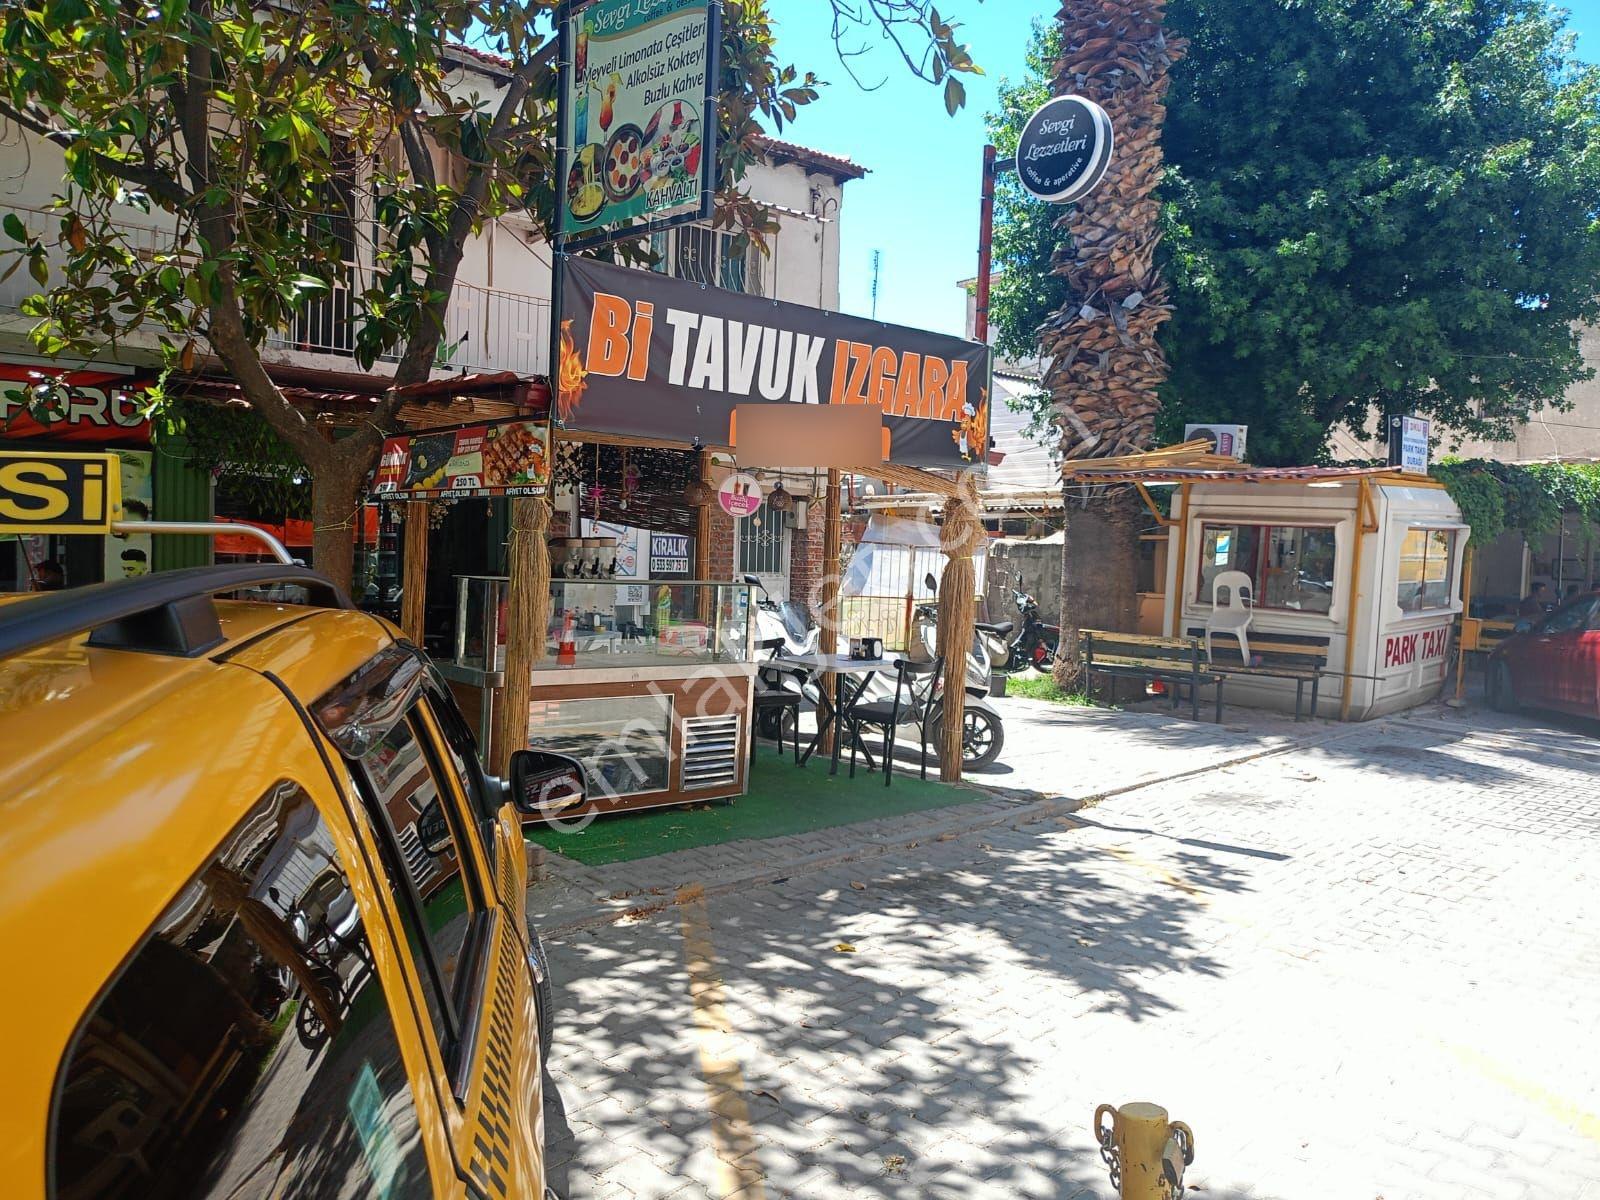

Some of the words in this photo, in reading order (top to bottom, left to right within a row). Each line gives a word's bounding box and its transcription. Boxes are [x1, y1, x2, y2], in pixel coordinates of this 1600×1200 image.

[582, 55, 616, 84] Meyveli
[619, 38, 663, 70] Limonata
[665, 19, 707, 52] Çeşitleri
[626, 62, 665, 90] Alkolsüz
[667, 42, 706, 74] Kokteyl
[644, 82, 670, 106] Buzlu
[672, 72, 704, 95] Kahve
[1040, 114, 1076, 135] Sevgi
[1024, 134, 1088, 161] Lezzetleri
[1026, 166, 1042, 185] coffee
[645, 178, 699, 209] KAHVALTI
[665, 308, 826, 404] TAVUK
[455, 478, 467, 487] 250
[468, 477, 476, 486] TL
[1384, 633, 1418, 668] PARK
